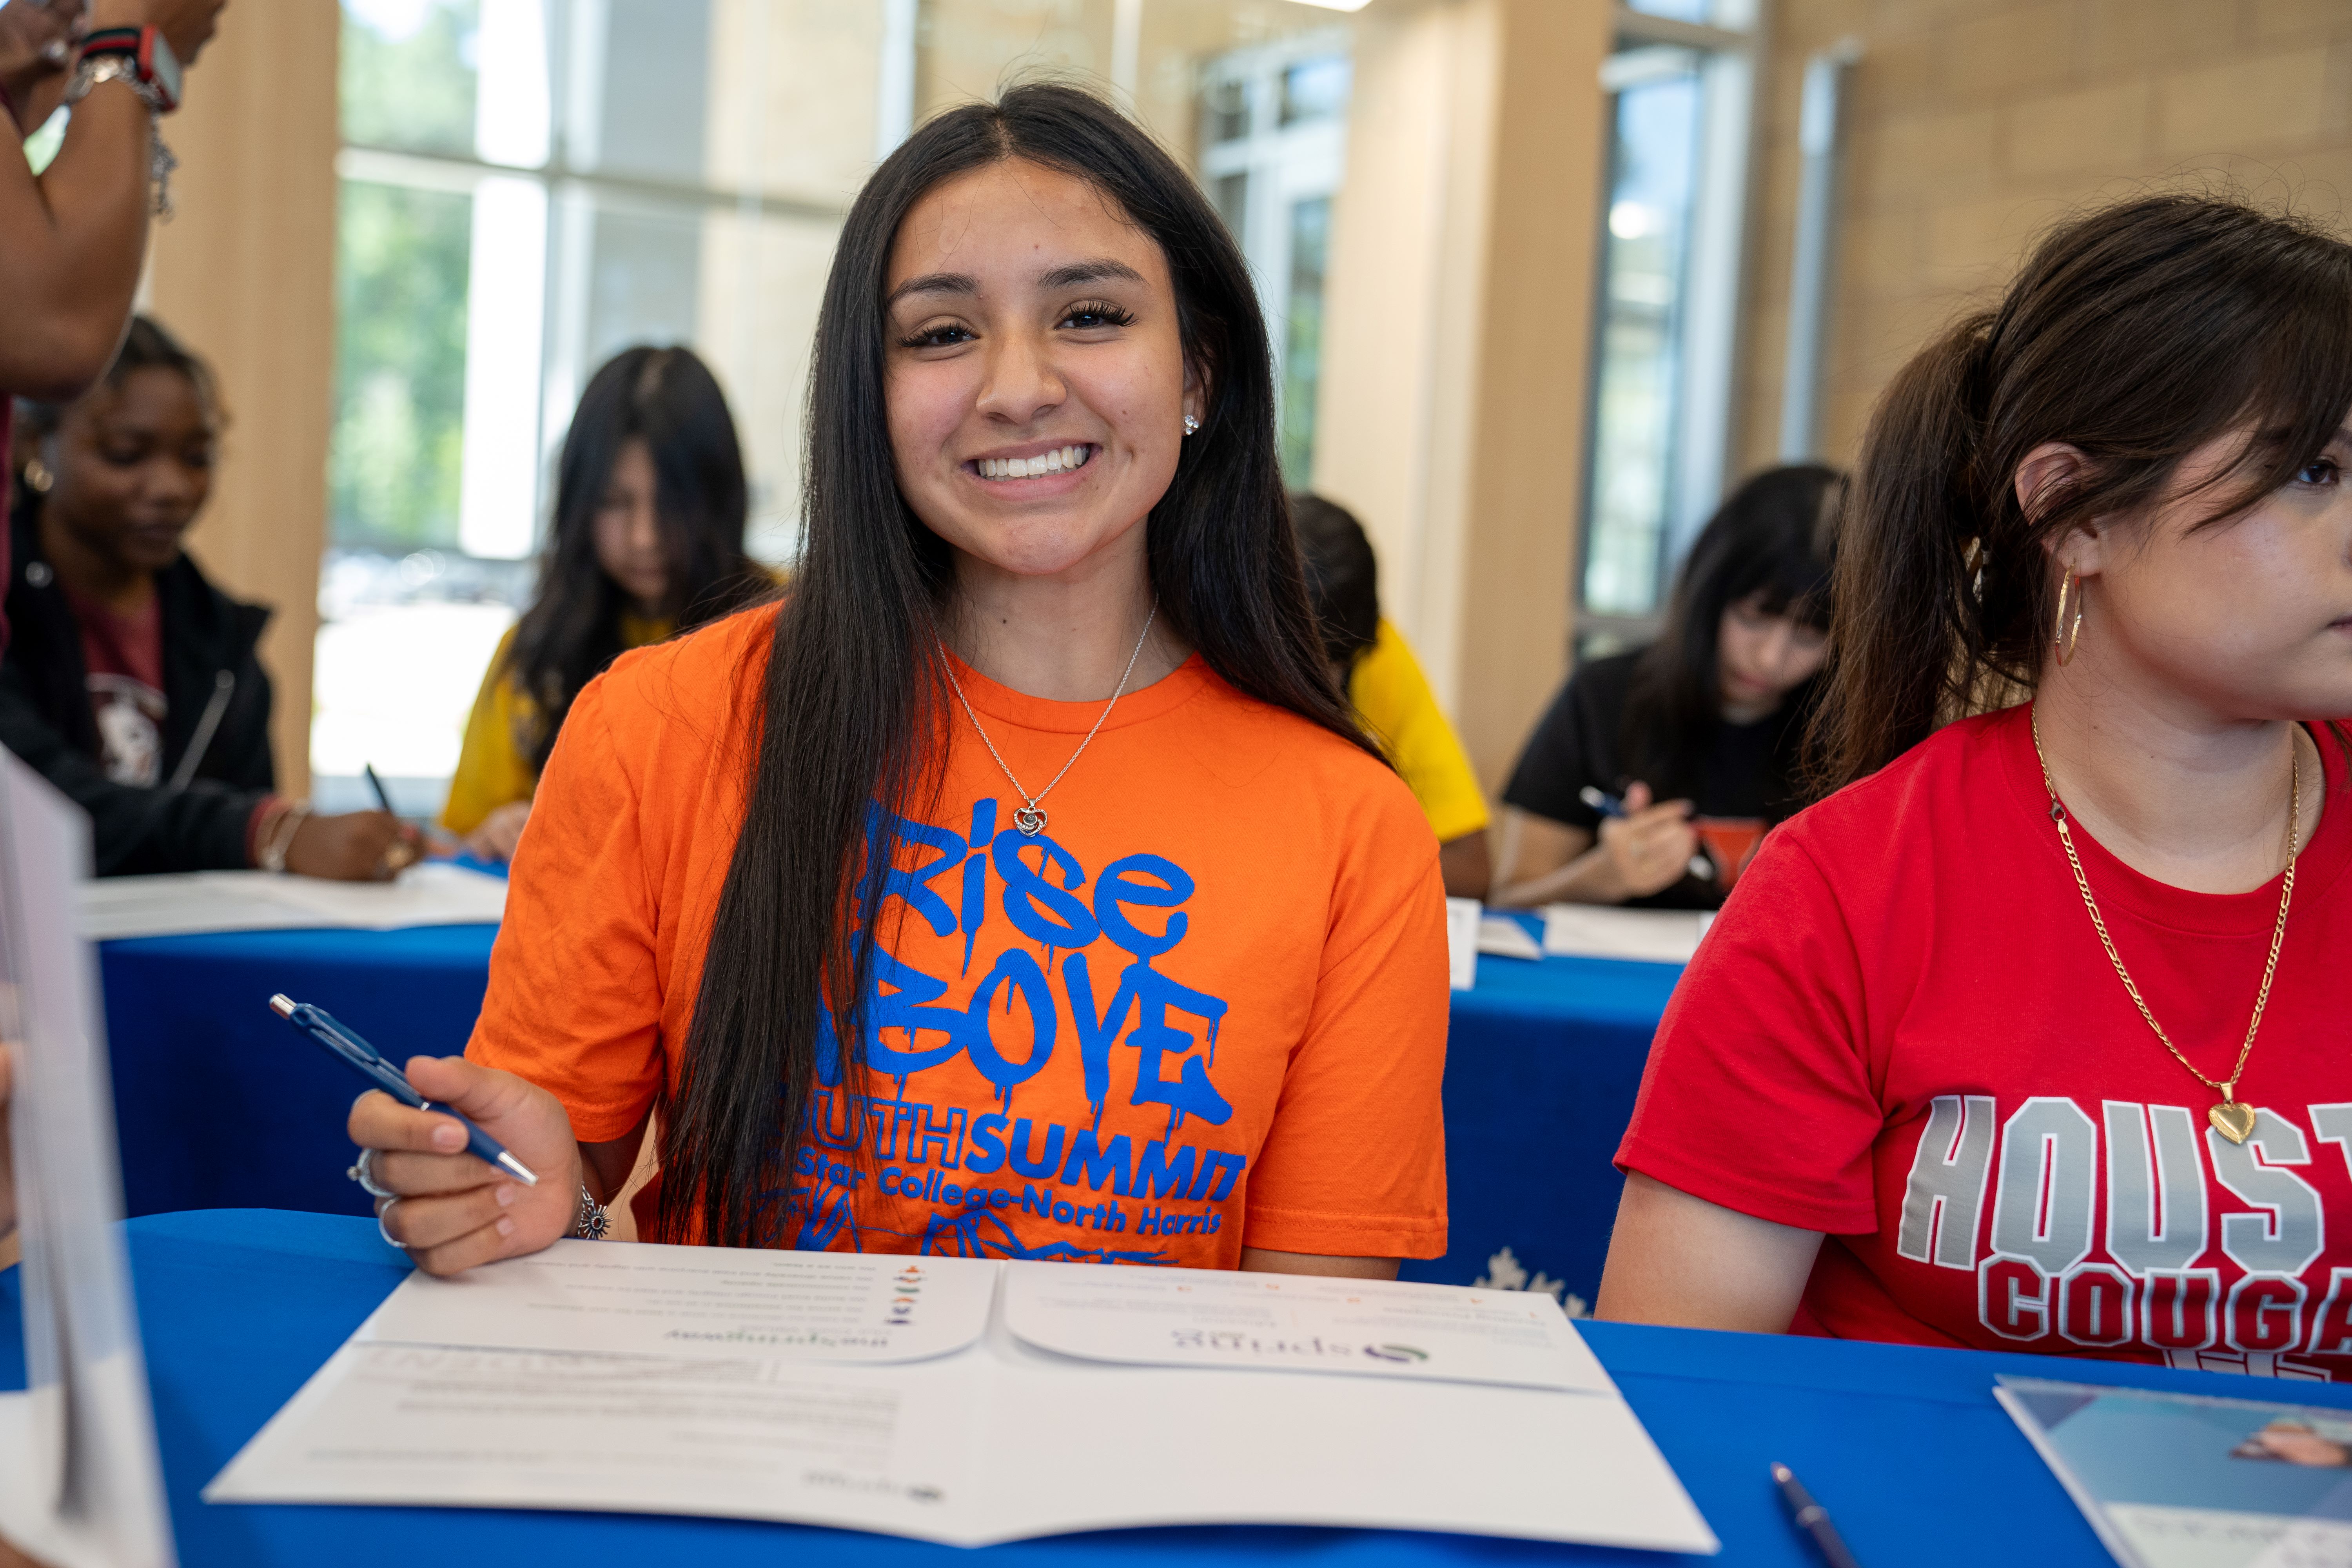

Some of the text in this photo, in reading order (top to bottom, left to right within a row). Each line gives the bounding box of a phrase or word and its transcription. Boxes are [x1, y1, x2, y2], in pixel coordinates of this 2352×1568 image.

[815, 931, 1233, 1131] BOVE
[795, 1146, 1222, 1236] Star College-North Harris
